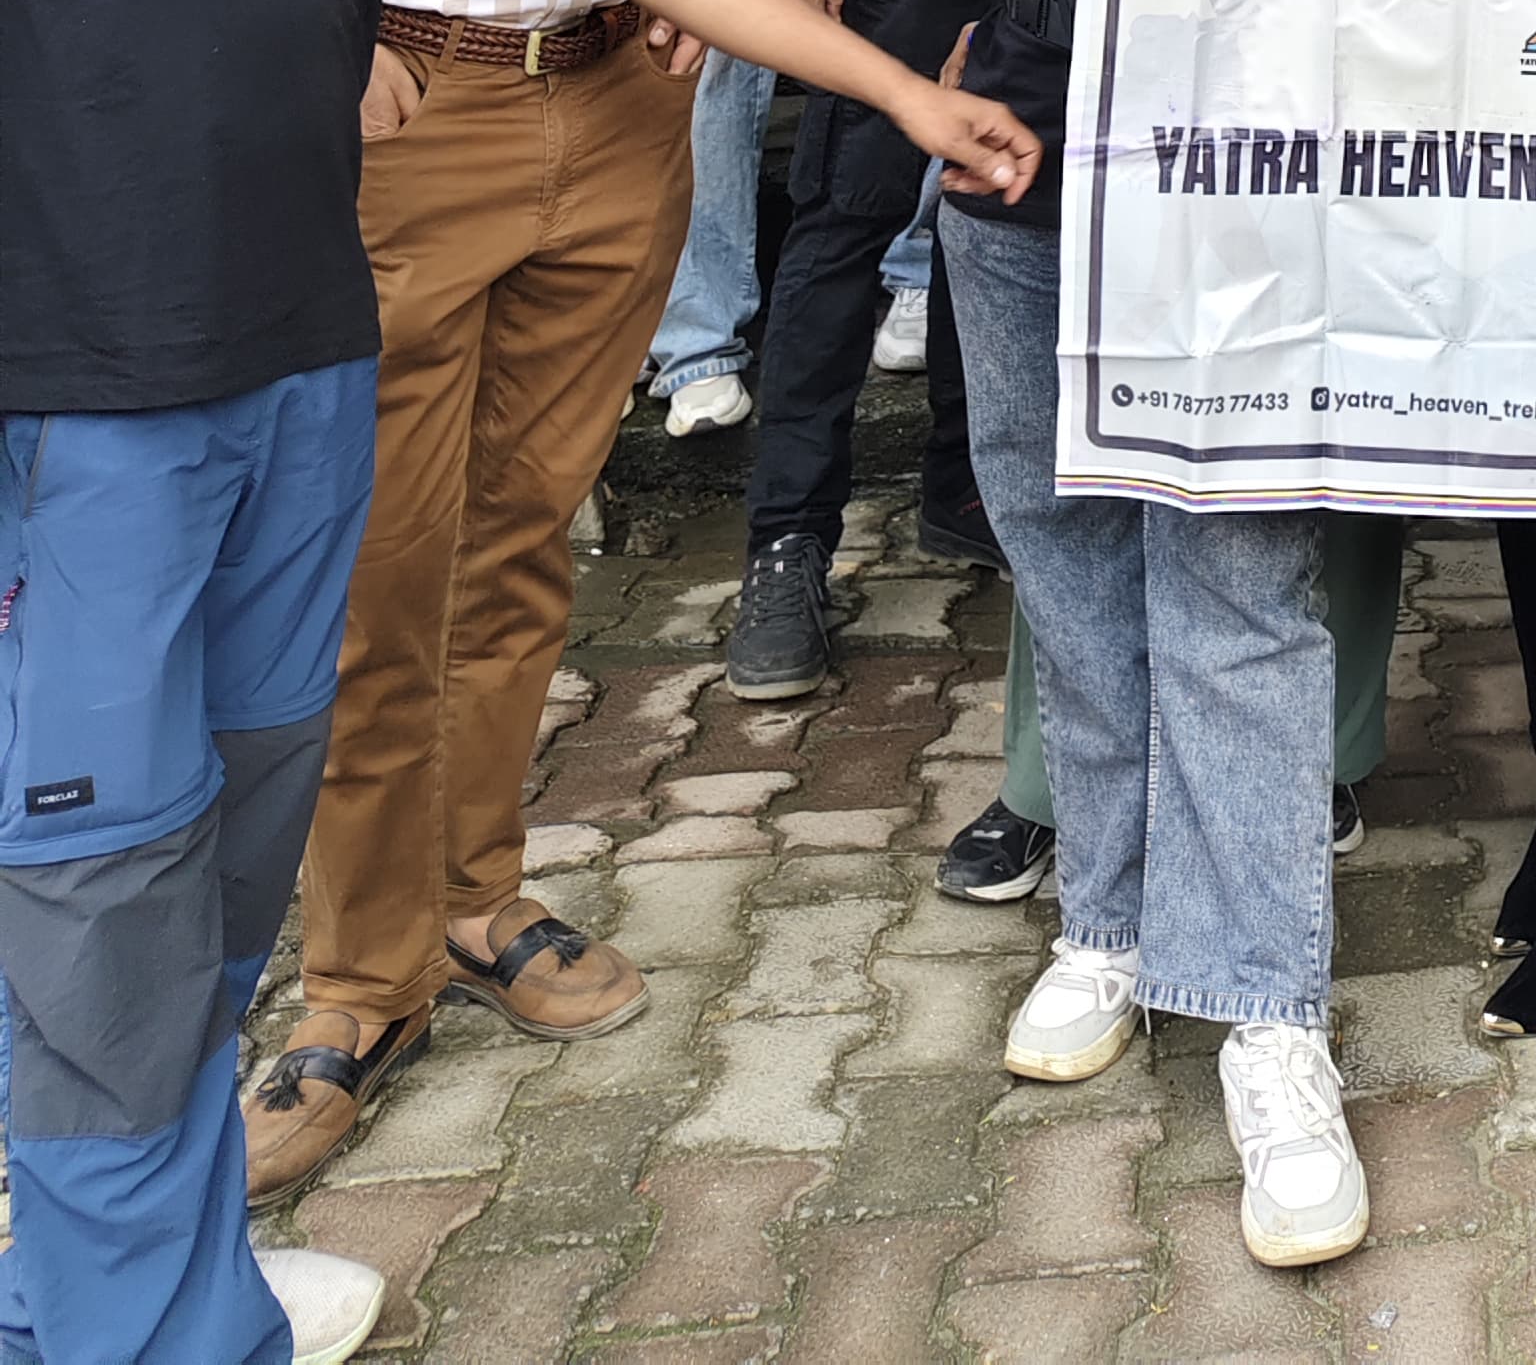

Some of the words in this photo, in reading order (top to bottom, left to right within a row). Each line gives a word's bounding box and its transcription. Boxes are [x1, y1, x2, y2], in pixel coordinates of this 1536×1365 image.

[1152, 126, 1319, 195] YATRA
[1173, 393, 1225, 416] 78773
[1229, 393, 1289, 413] 77433
